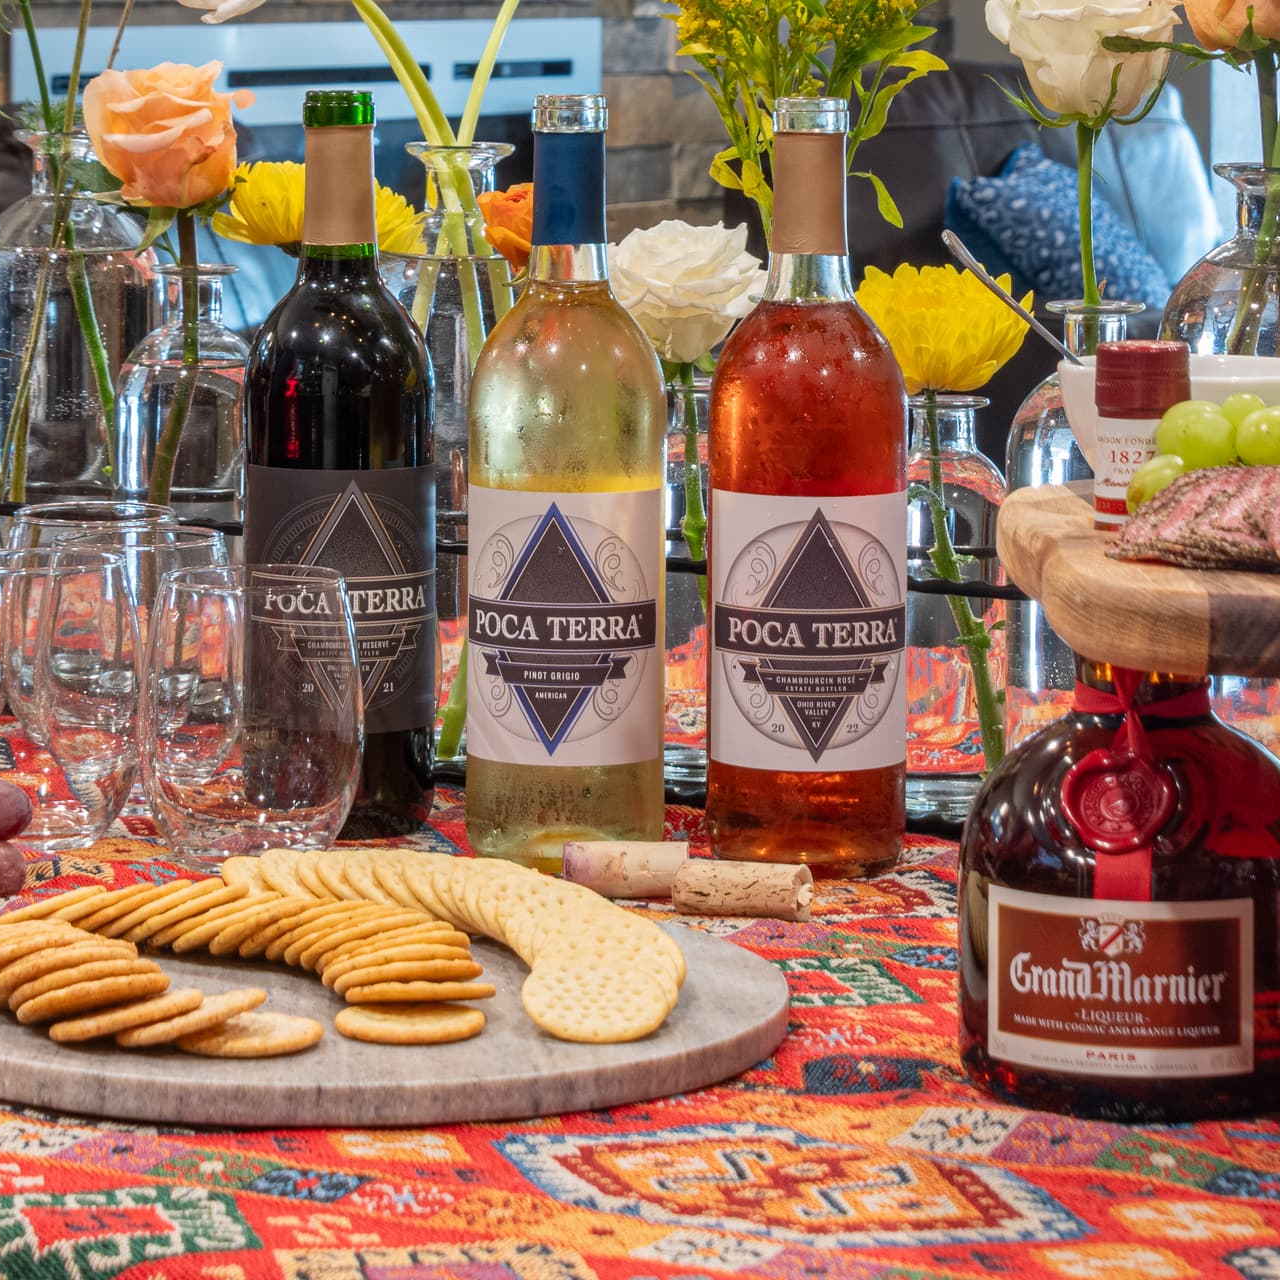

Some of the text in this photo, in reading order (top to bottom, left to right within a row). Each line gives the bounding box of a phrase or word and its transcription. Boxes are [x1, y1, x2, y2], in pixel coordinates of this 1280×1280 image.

[1110, 449, 1156, 464] 1827
[1113, 467, 1137, 475] FRAN
[264, 585, 427, 615] POCA TERRA
[475, 608, 642, 642] POCA TERRA
[728, 616, 898, 648] POCA TERRA
[523, 670, 580, 681] PINOT GRIGIO
[776, 674, 856, 686] CHAMBOURCIN ROSÉ
[302, 682, 314, 693] 20
[383, 682, 394, 693] 21
[815, 685, 847, 693] BOTTLED
[535, 692, 568, 700] AMERICAN
[796, 700, 837, 709] OHIO RIVER
[804, 708, 829, 716] VALLEY
[771, 723, 785, 734] 20
[846, 723, 860, 734] 22
[1009, 951, 1226, 1005] Grand Marnier
[1080, 1007, 1144, 1025] LIQUEUR
[1014, 1013, 1221, 1038] MADE WITH COGNAC AND ORANGE LIQUEUR
[1086, 1049, 1137, 1062] PARIS
